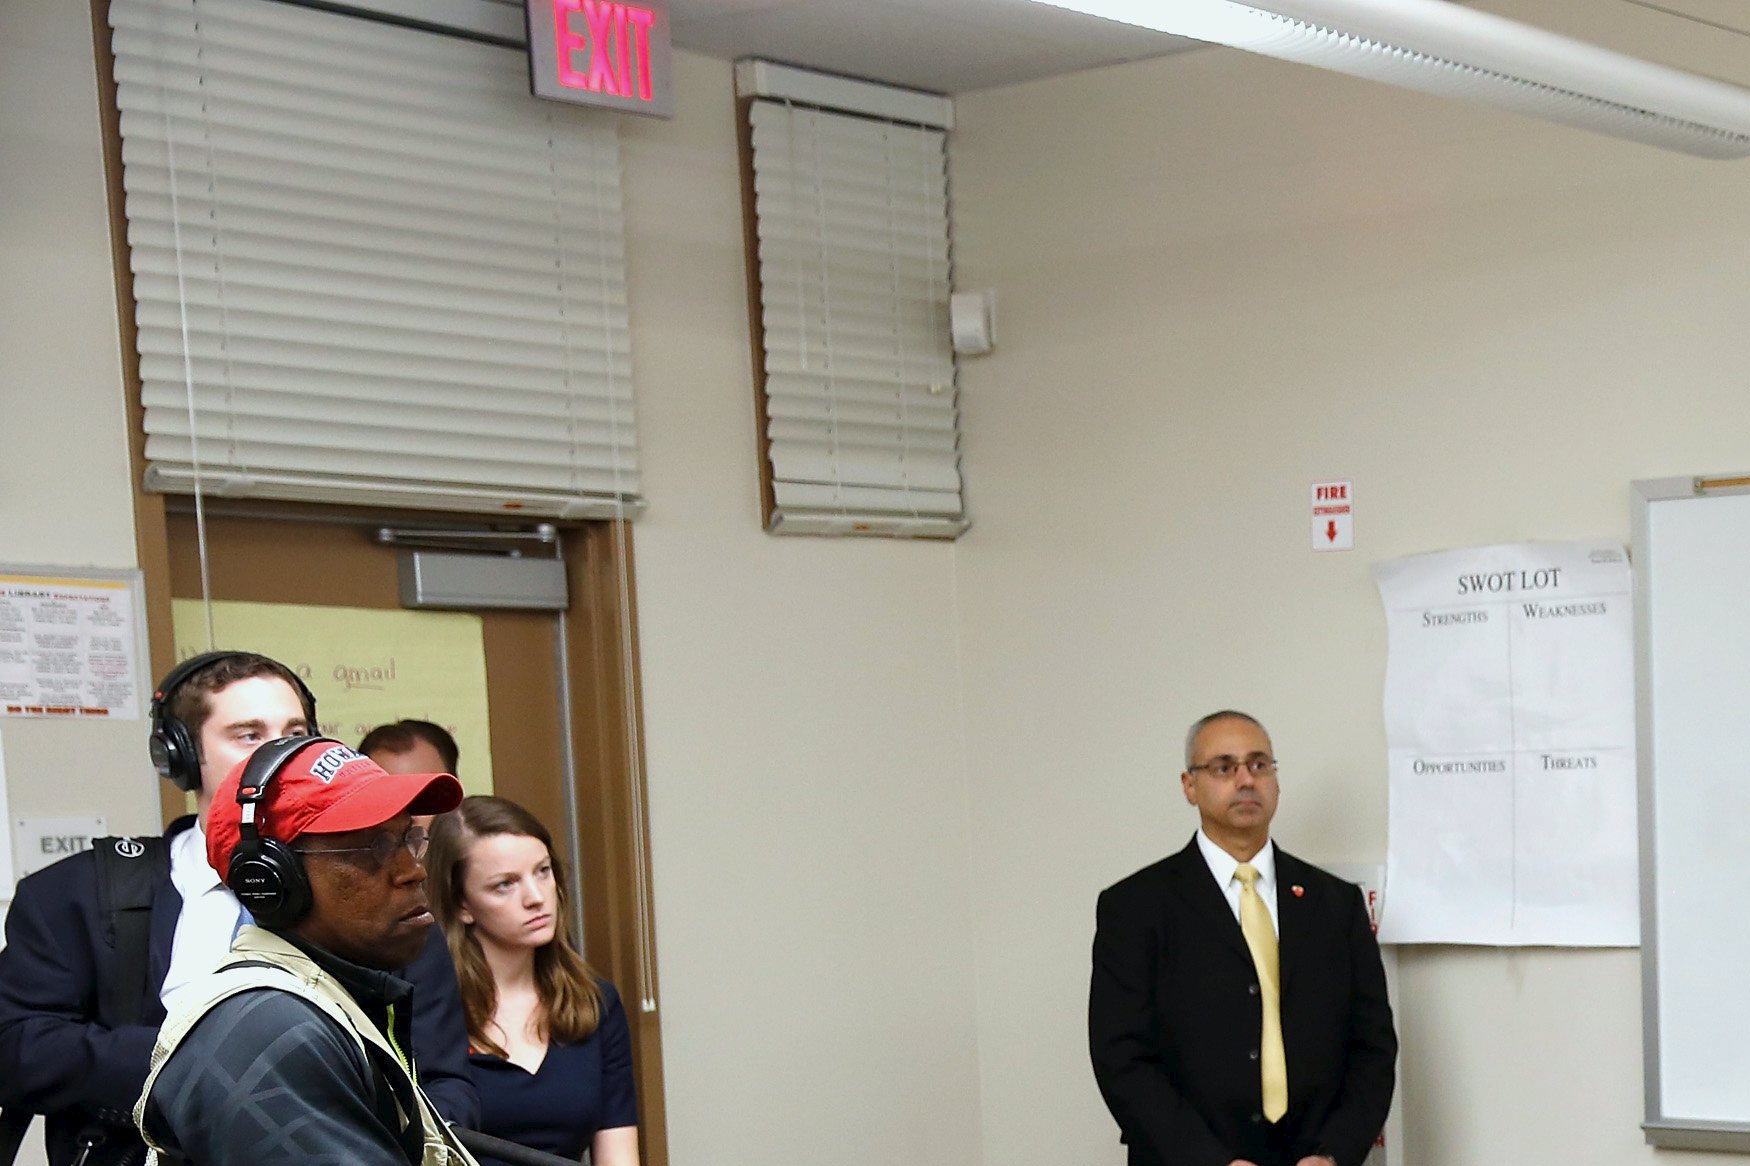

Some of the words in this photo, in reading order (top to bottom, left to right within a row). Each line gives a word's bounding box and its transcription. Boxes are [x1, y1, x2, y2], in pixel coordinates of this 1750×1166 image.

[554, 0, 656, 101] EXIT
[1317, 485, 1347, 500] FIRE
[1457, 570, 1515, 595] SWOT
[1521, 567, 1562, 590] LOT
[1523, 602, 1607, 619] WEAKNESSES
[333, 657, 396, 691] gmail
[1413, 757, 1505, 775] OPPORTUNITIES
[1541, 753, 1598, 770] THREATS
[41, 836, 87, 853] EXIT
